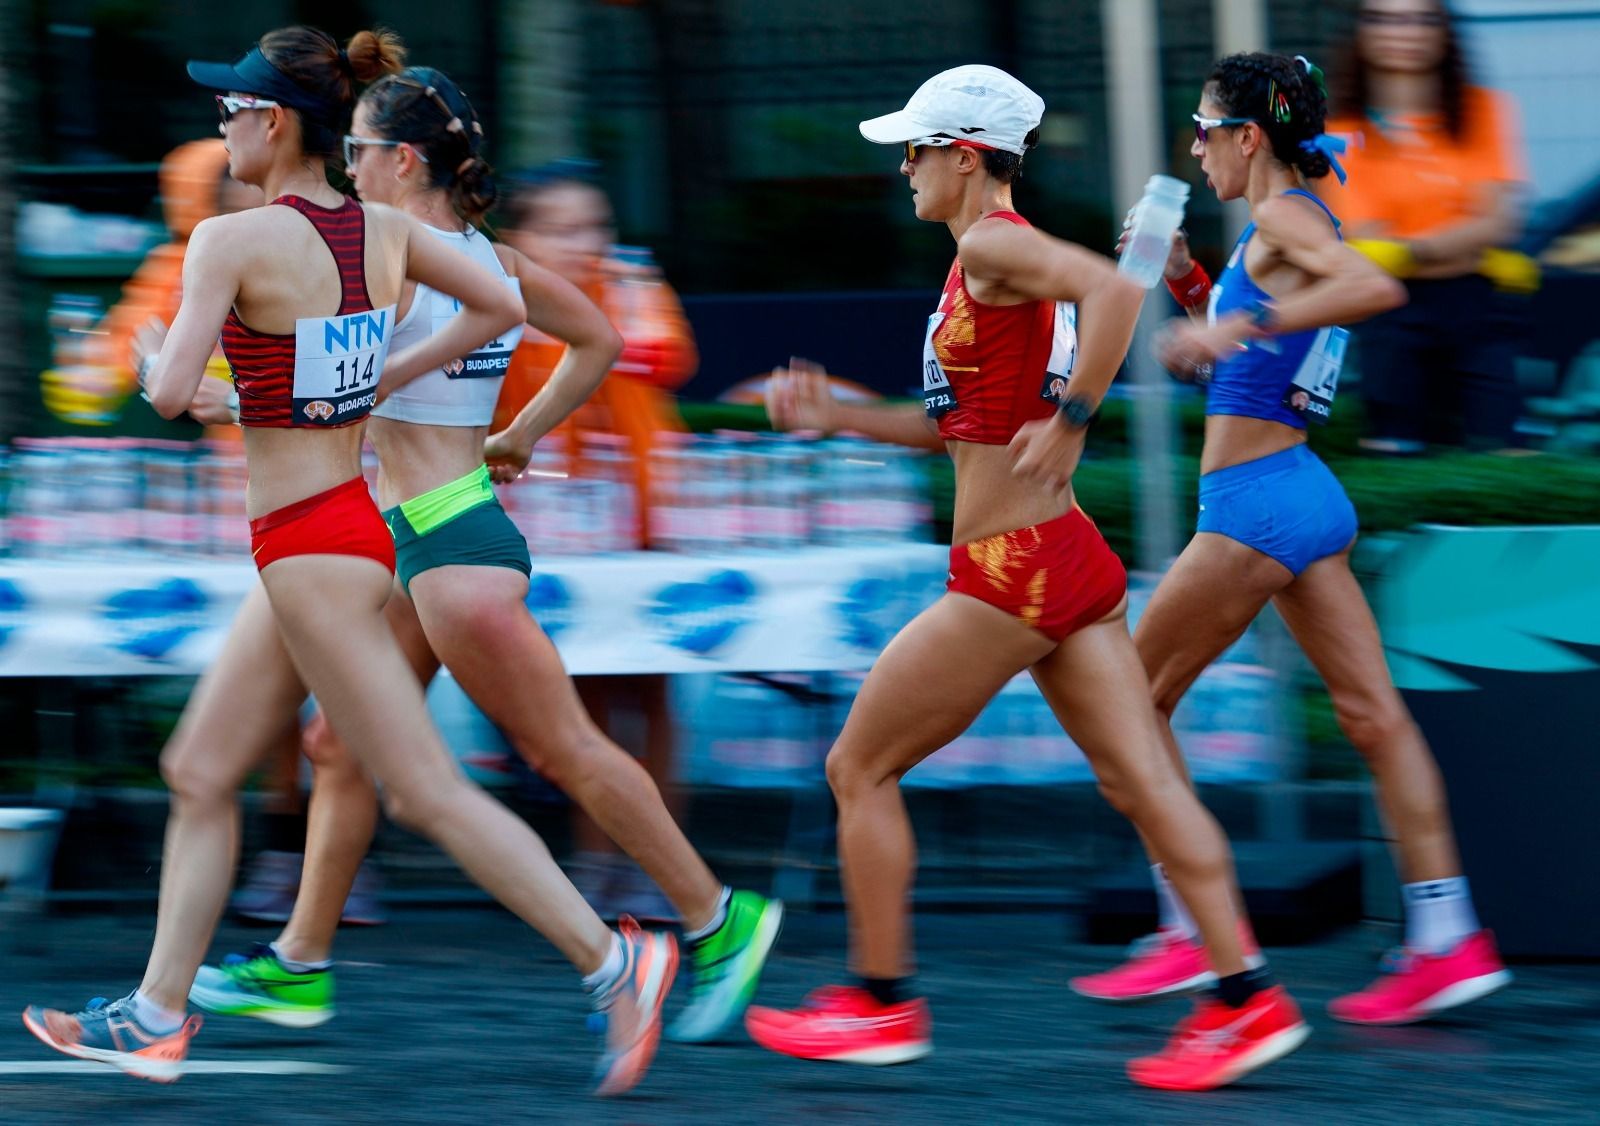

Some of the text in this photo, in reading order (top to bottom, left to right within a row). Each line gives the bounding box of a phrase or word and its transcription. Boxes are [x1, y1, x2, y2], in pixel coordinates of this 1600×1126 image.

[325, 311, 386, 354] NTN
[335, 353, 375, 393] 114
[925, 359, 943, 385] 127
[937, 393, 951, 407] 23
